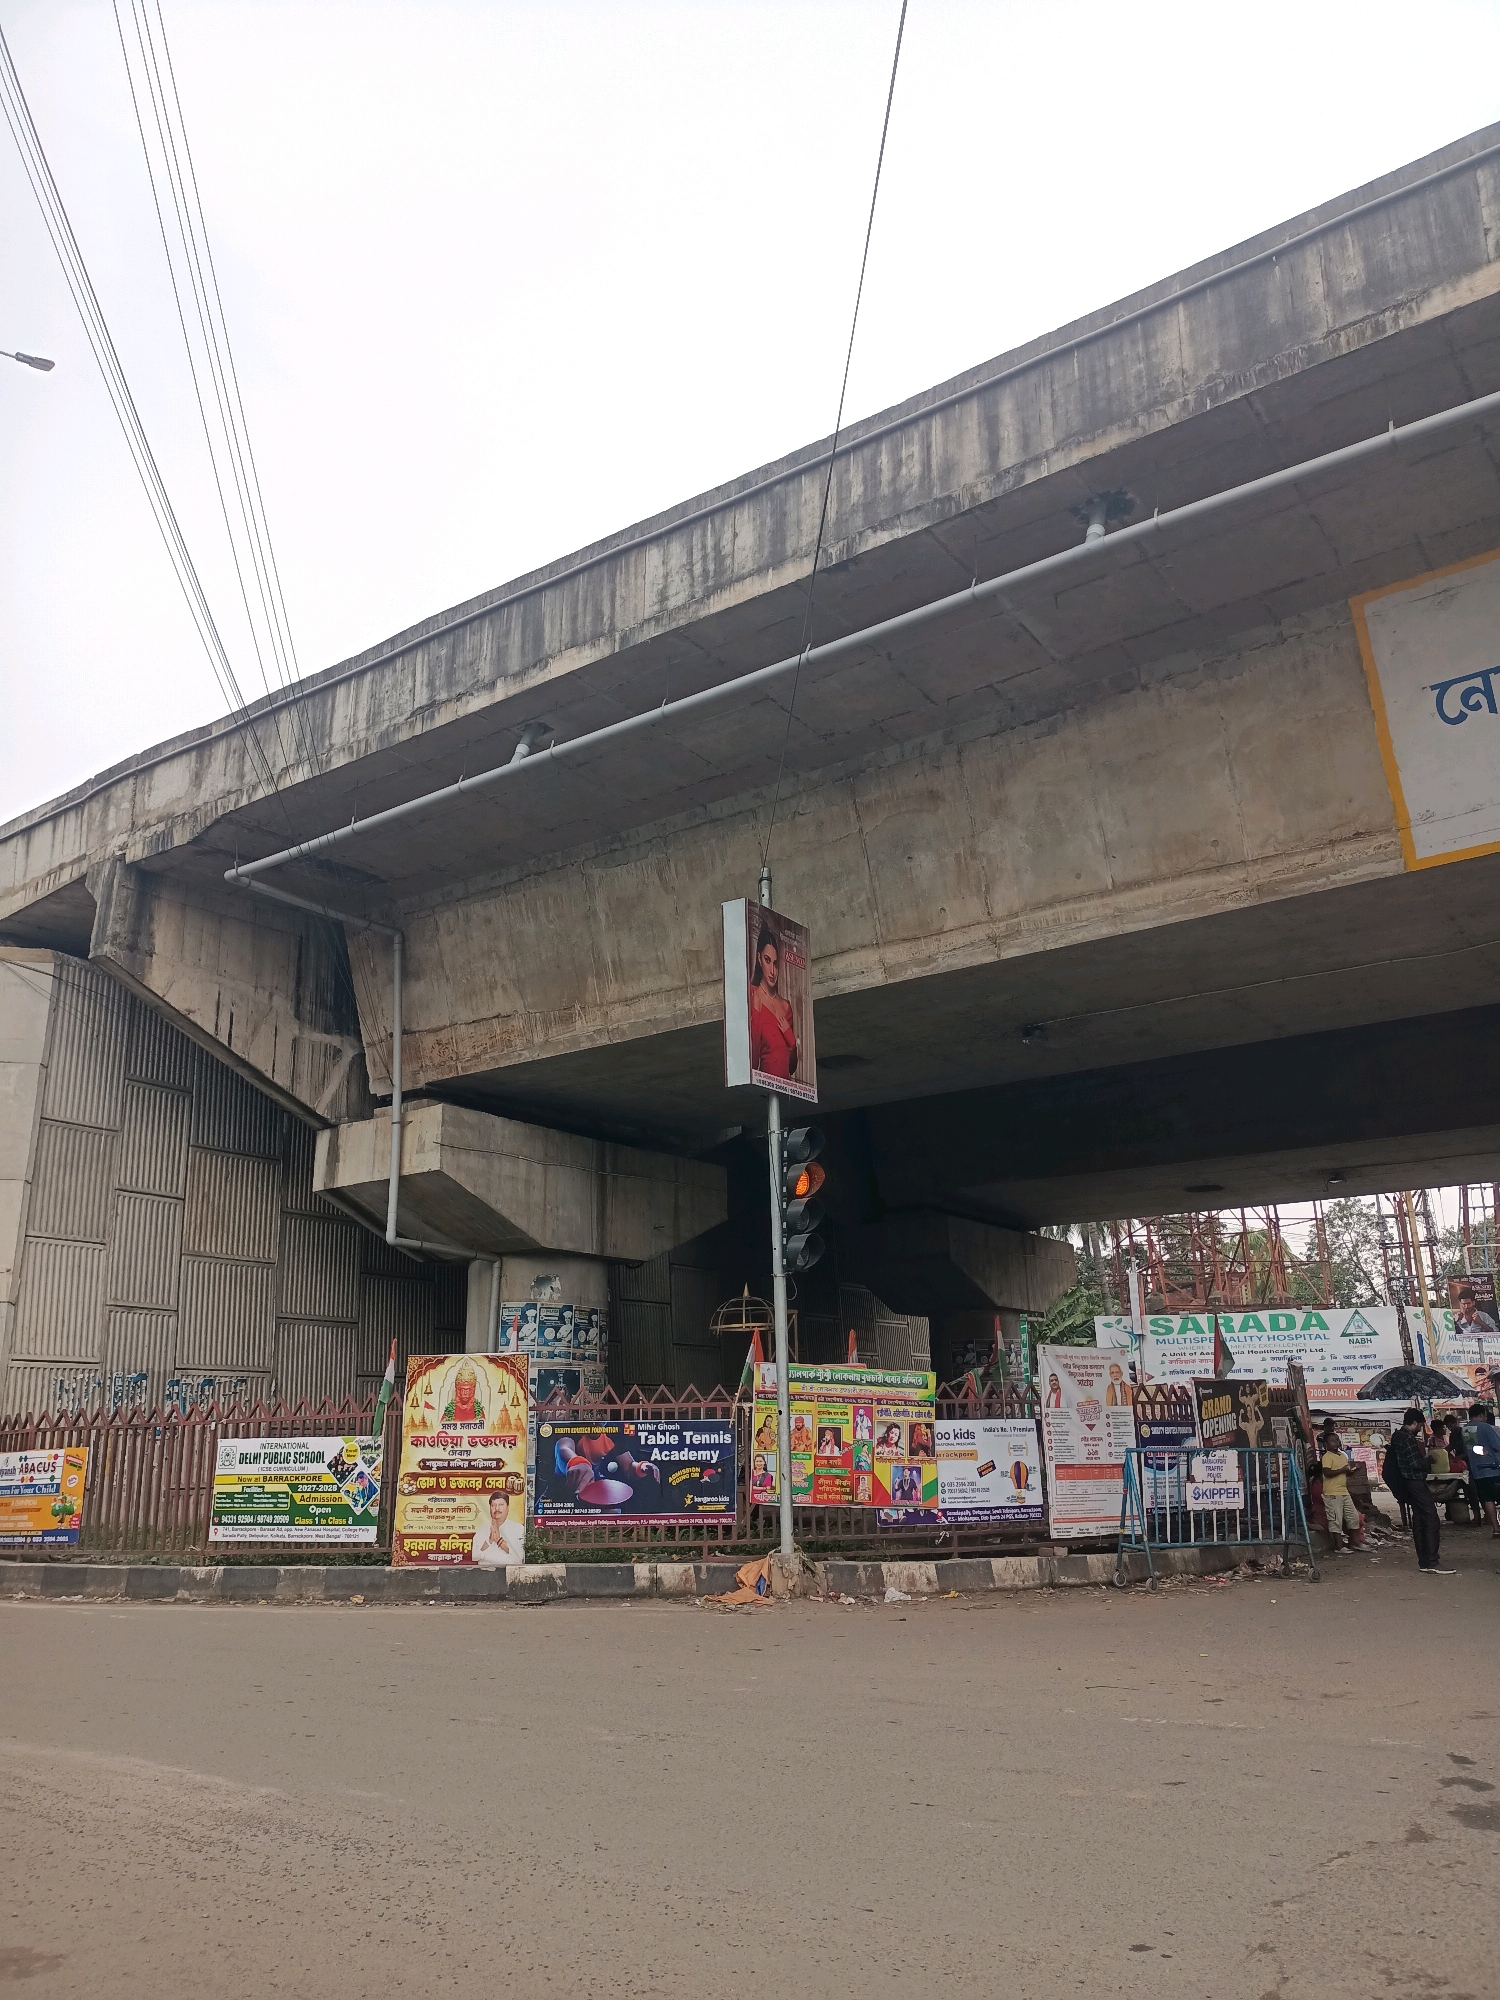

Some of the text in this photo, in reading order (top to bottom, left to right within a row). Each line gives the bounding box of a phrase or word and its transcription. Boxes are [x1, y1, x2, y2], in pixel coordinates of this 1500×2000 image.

[1149, 1311, 1331, 1336] SARADA
[1155, 1332, 1331, 1345] MULTISPEIALITY HOSPITAL
[1348, 1337, 1373, 1346] NABH
[1295, 1347, 1308, 1355] (P)
[1310, 1388, 1349, 1398] 70037 47642
[1201, 1394, 1232, 1420] GRAND
[441, 1419, 485, 1431] সমস্ত সনাতনী
[637, 1423, 680, 1431] Mihir Ghosh
[982, 1426, 1000, 1434] India's
[1202, 1412, 1238, 1439] OPENING
[638, 1430, 732, 1445] Table Tennis
[953, 1428, 976, 1440] kids
[259, 1441, 310, 1450] INTERNATIONAL
[467, 1434, 518, 1450] ভক্তদের
[238, 1450, 326, 1465] DELHI PUBLIC SCHOOL
[448, 1449, 472, 1457] সেবায়
[650, 1447, 720, 1463] Academy
[936, 1451, 975, 1459] arrackpore
[20, 1461, 57, 1474] ABACUS
[262, 1475, 323, 1483] BARRACKPORE
[668, 1466, 701, 1483] ADMISSION
[671, 1474, 691, 1486] GOING
[11, 1484, 56, 1494] For Your Child
[416, 1476, 507, 1491] ভোগ ও ভজনের সেবা
[299, 1494, 343, 1503] Admission
[694, 1495, 719, 1504] kangaroo
[308, 1505, 331, 1514] Open
[451, 1505, 472, 1513] সমিতি
[294, 1516, 313, 1525] Class
[314, 1516, 319, 1524] 1
[327, 1516, 347, 1524] Class
[347, 1516, 353, 1525] 8
[403, 1533, 473, 1557] হনুমান মন্দির
